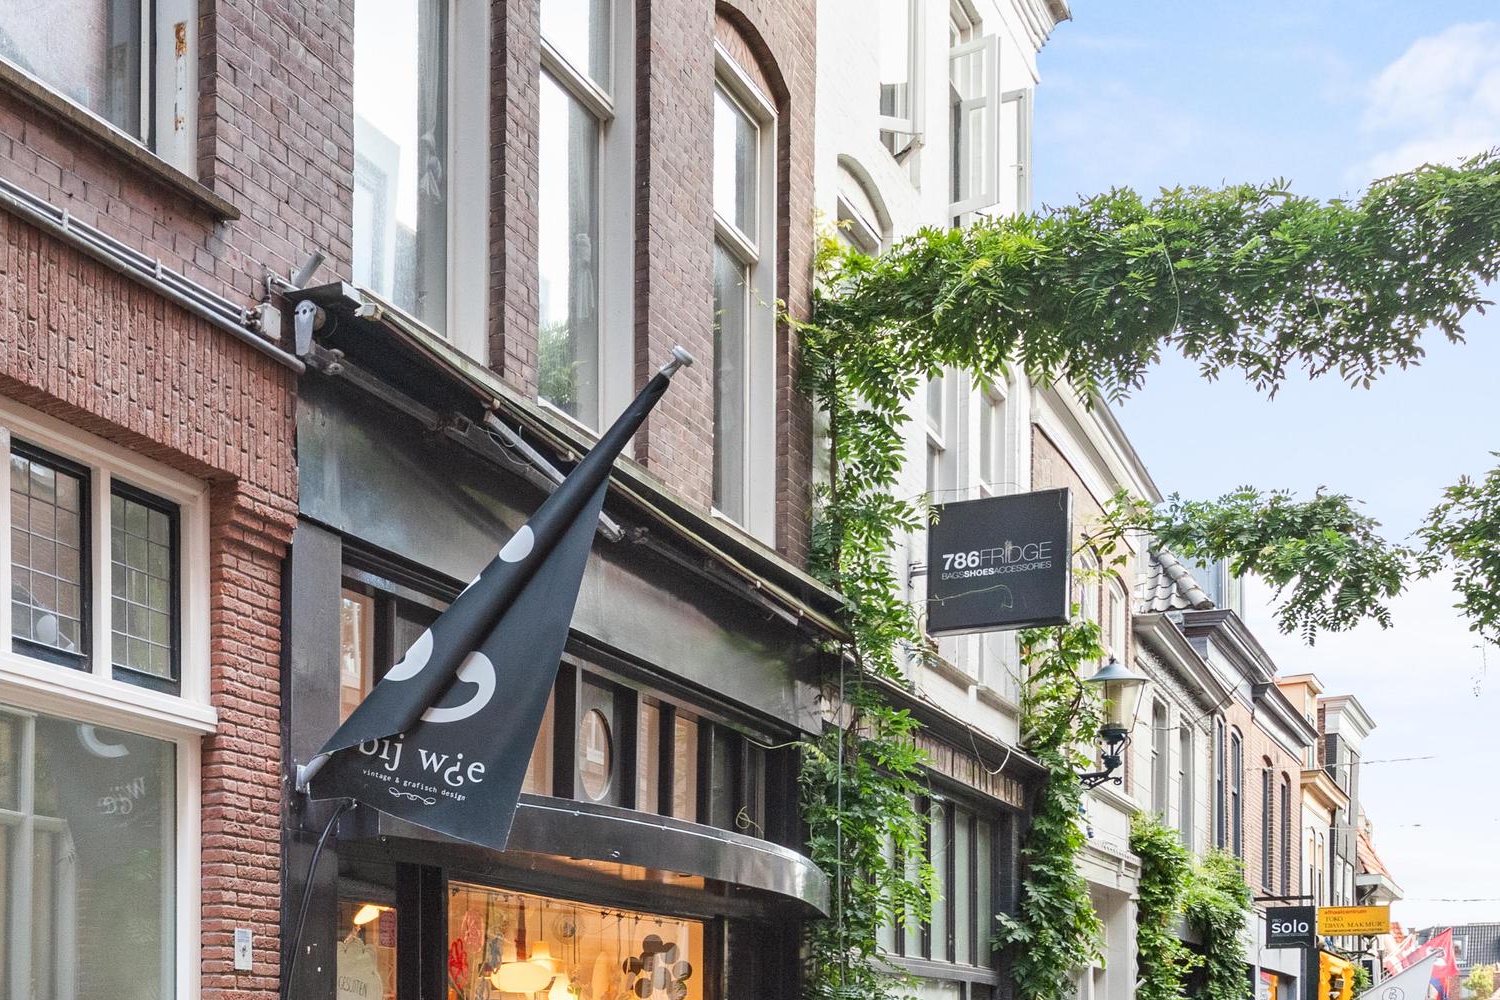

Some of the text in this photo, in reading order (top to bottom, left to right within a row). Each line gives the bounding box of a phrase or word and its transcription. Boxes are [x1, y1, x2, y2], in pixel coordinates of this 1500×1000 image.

[362, 769, 466, 801] vintage & grafisch design
[1271, 919, 1309, 934] solo
